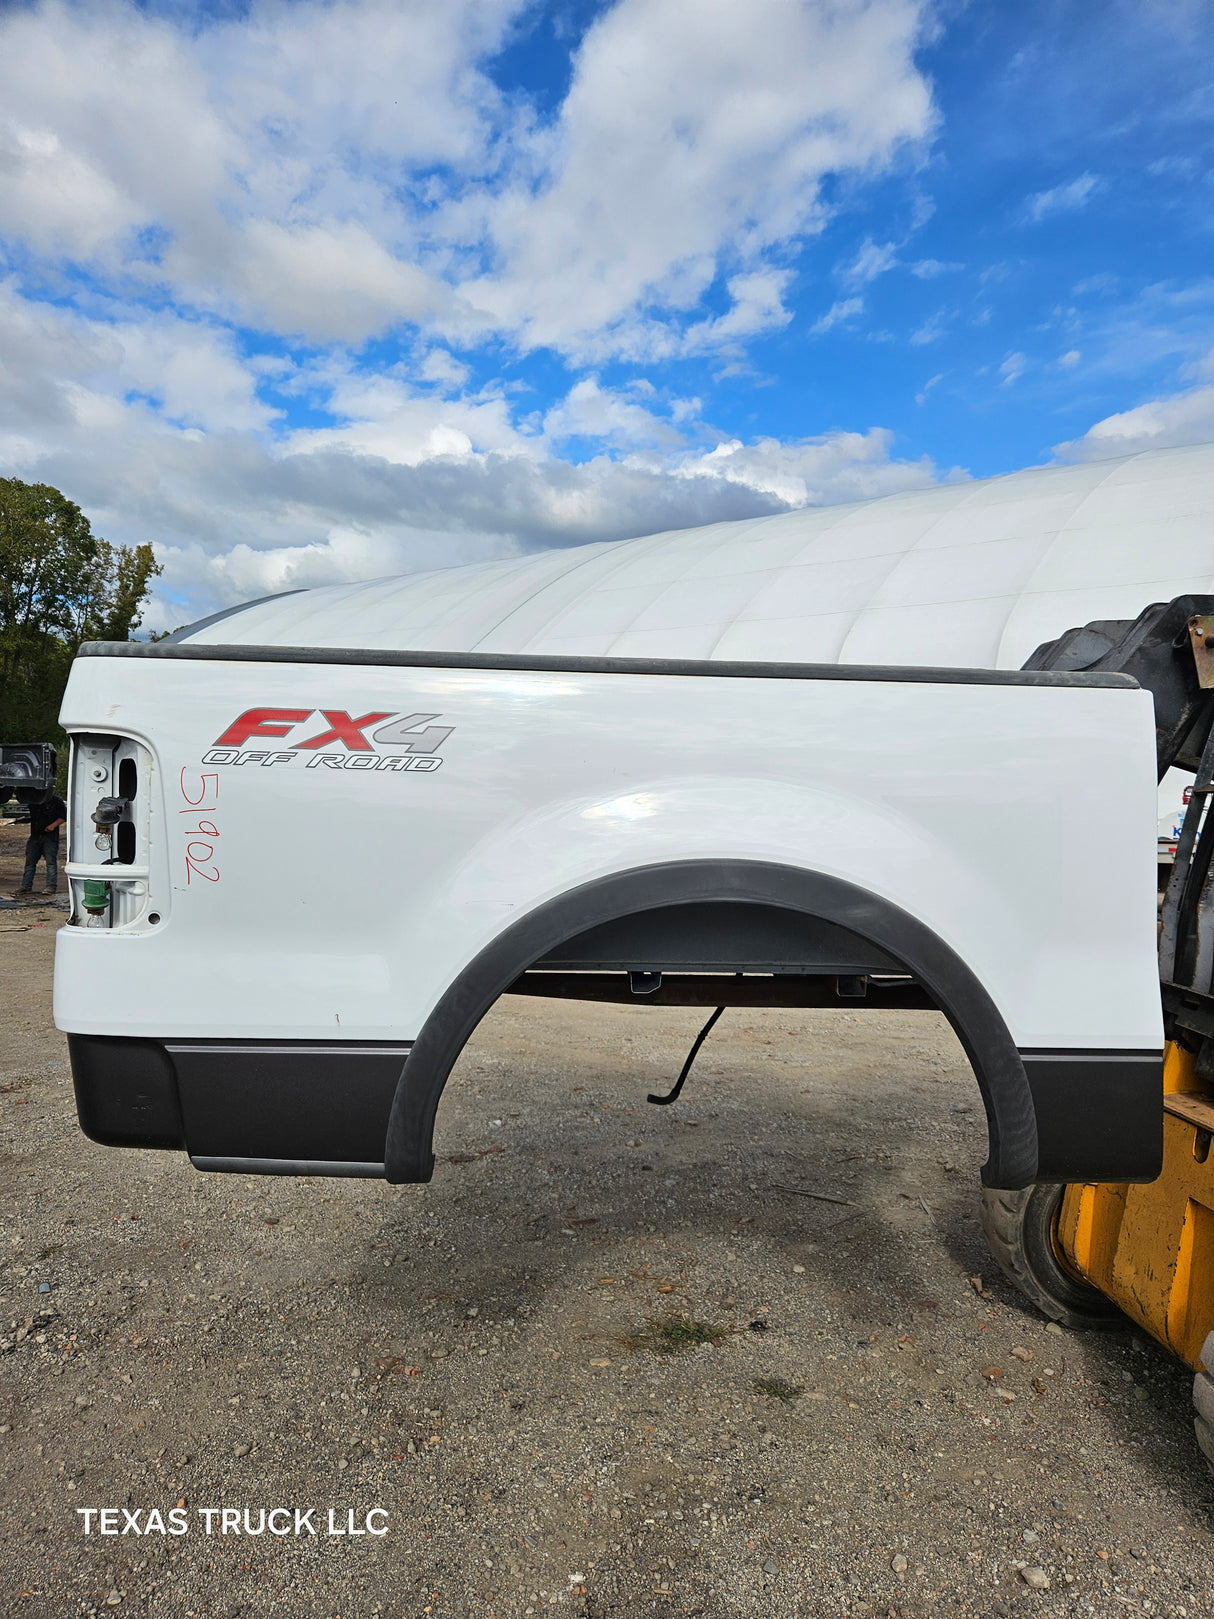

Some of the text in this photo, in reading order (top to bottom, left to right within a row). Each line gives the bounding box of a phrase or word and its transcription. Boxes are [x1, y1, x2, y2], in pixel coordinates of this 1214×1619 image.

[212, 707, 456, 753] FX4
[202, 749, 444, 772] OFF ROAD
[179, 766, 220, 885] 51902
